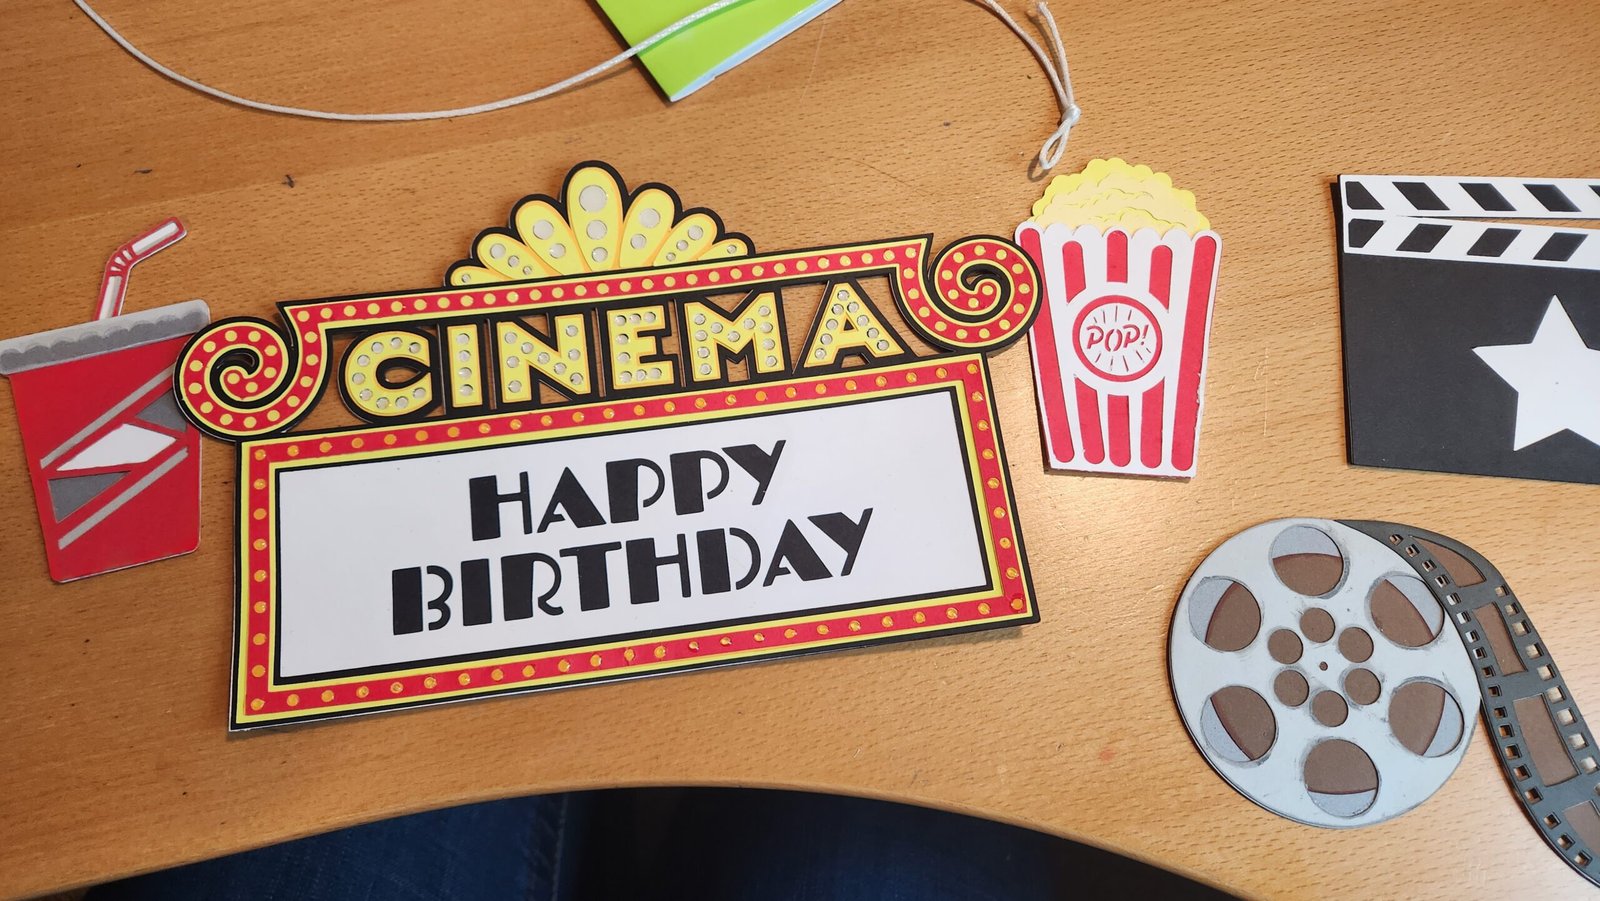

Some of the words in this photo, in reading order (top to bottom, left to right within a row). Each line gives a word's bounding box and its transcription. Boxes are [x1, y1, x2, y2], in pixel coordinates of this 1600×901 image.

[344, 282, 905, 416] CINEMA
[1086, 323, 1149, 352] POP!
[468, 439, 787, 542] HAPPY
[391, 507, 874, 636] BIRTHDAY
